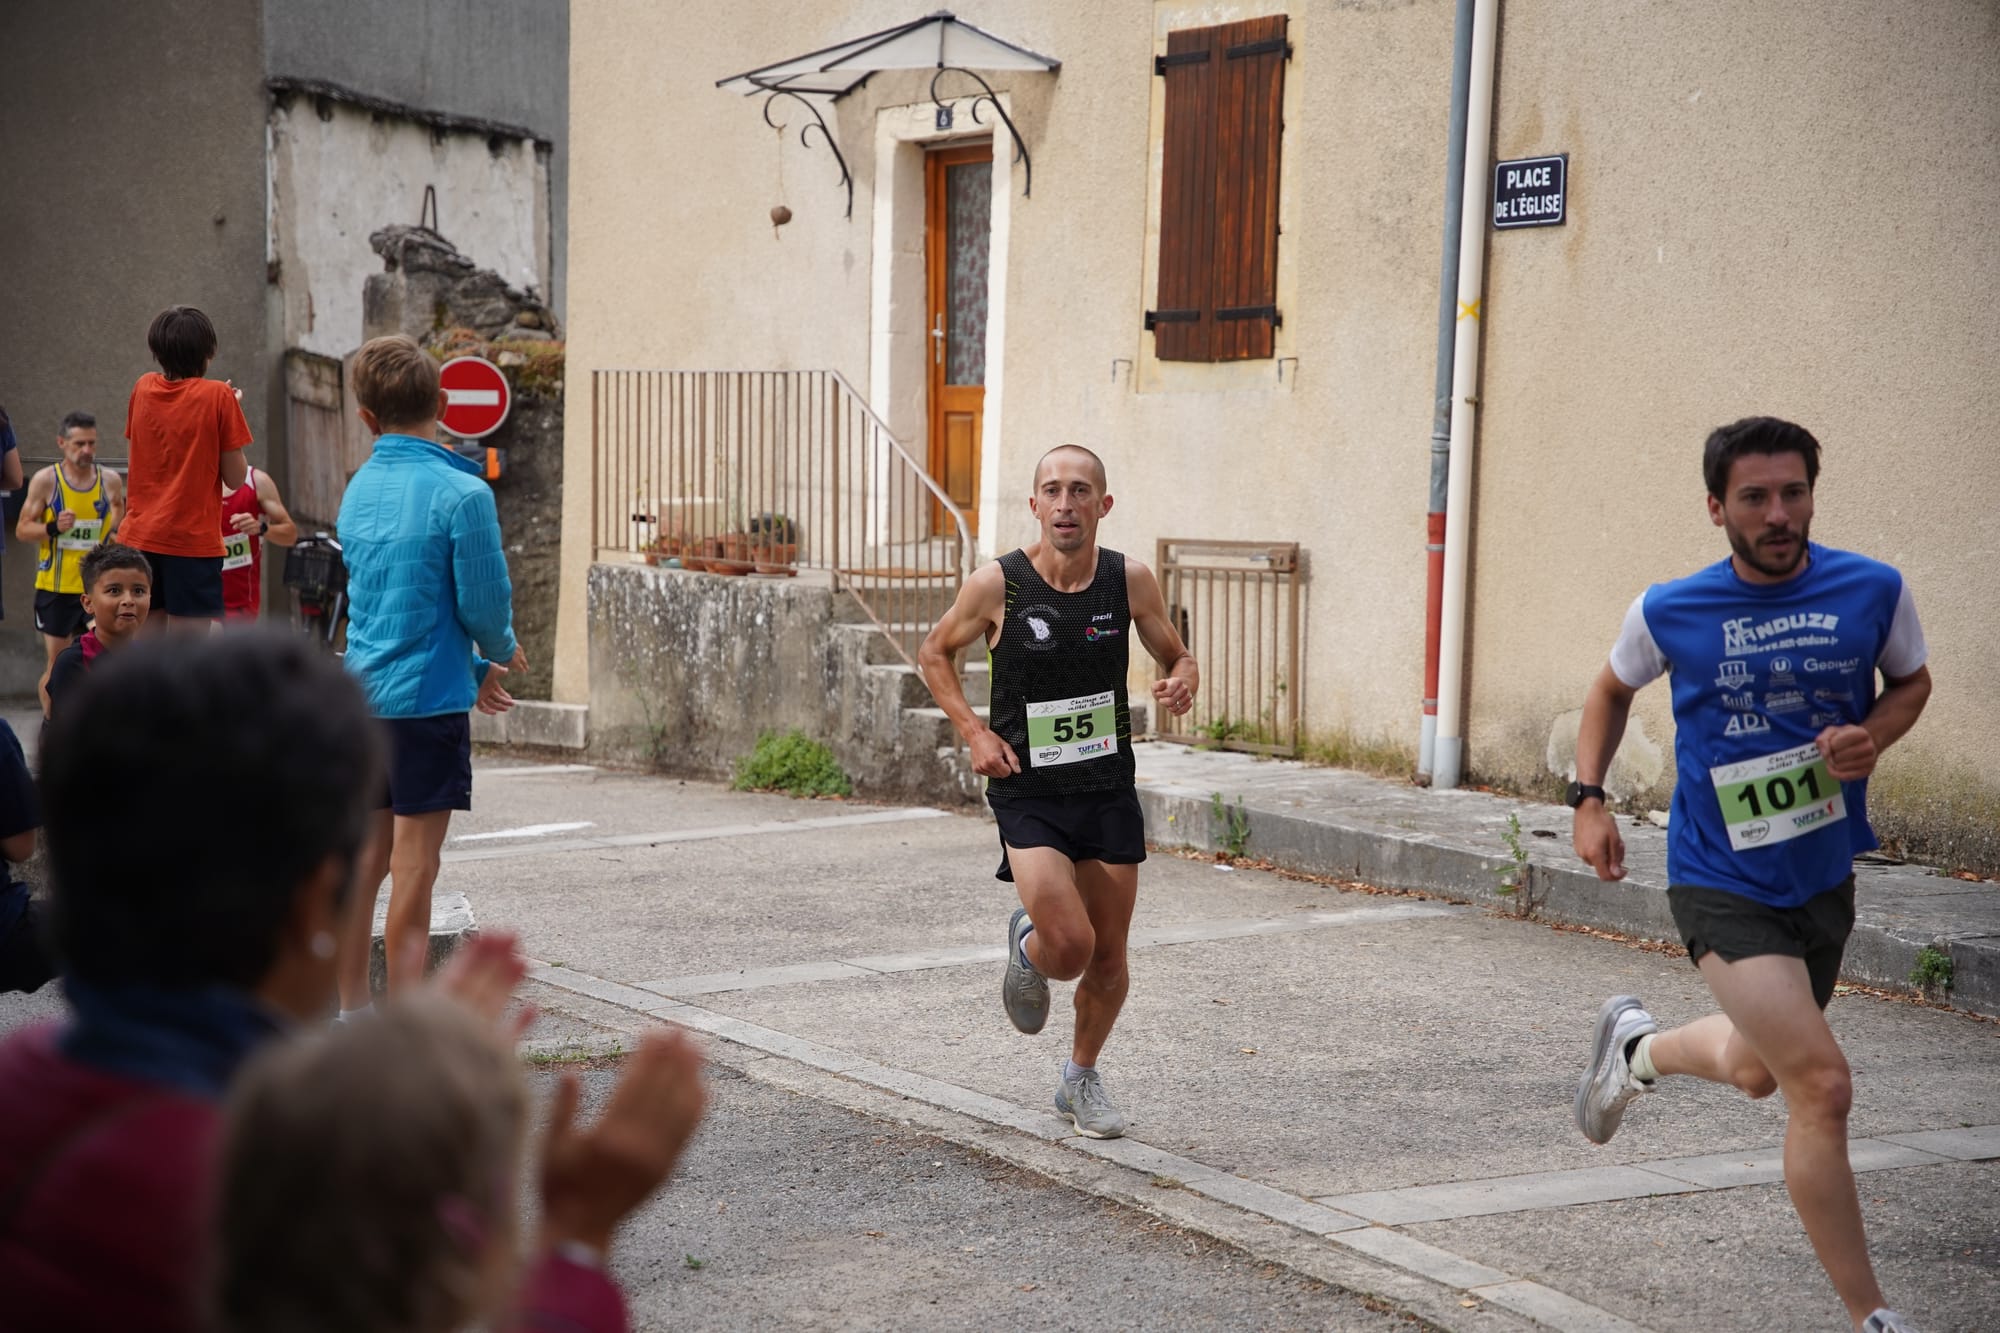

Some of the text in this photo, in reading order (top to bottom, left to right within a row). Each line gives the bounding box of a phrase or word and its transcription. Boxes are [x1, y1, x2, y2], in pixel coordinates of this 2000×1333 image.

[1507, 167, 1552, 189] PLACE
[1496, 193, 1561, 218] DE L'ÉGLISE
[70, 528, 91, 540] 48
[1774, 661, 1787, 672] U
[1054, 713, 1094, 742] 55
[1738, 768, 1820, 817] 101
